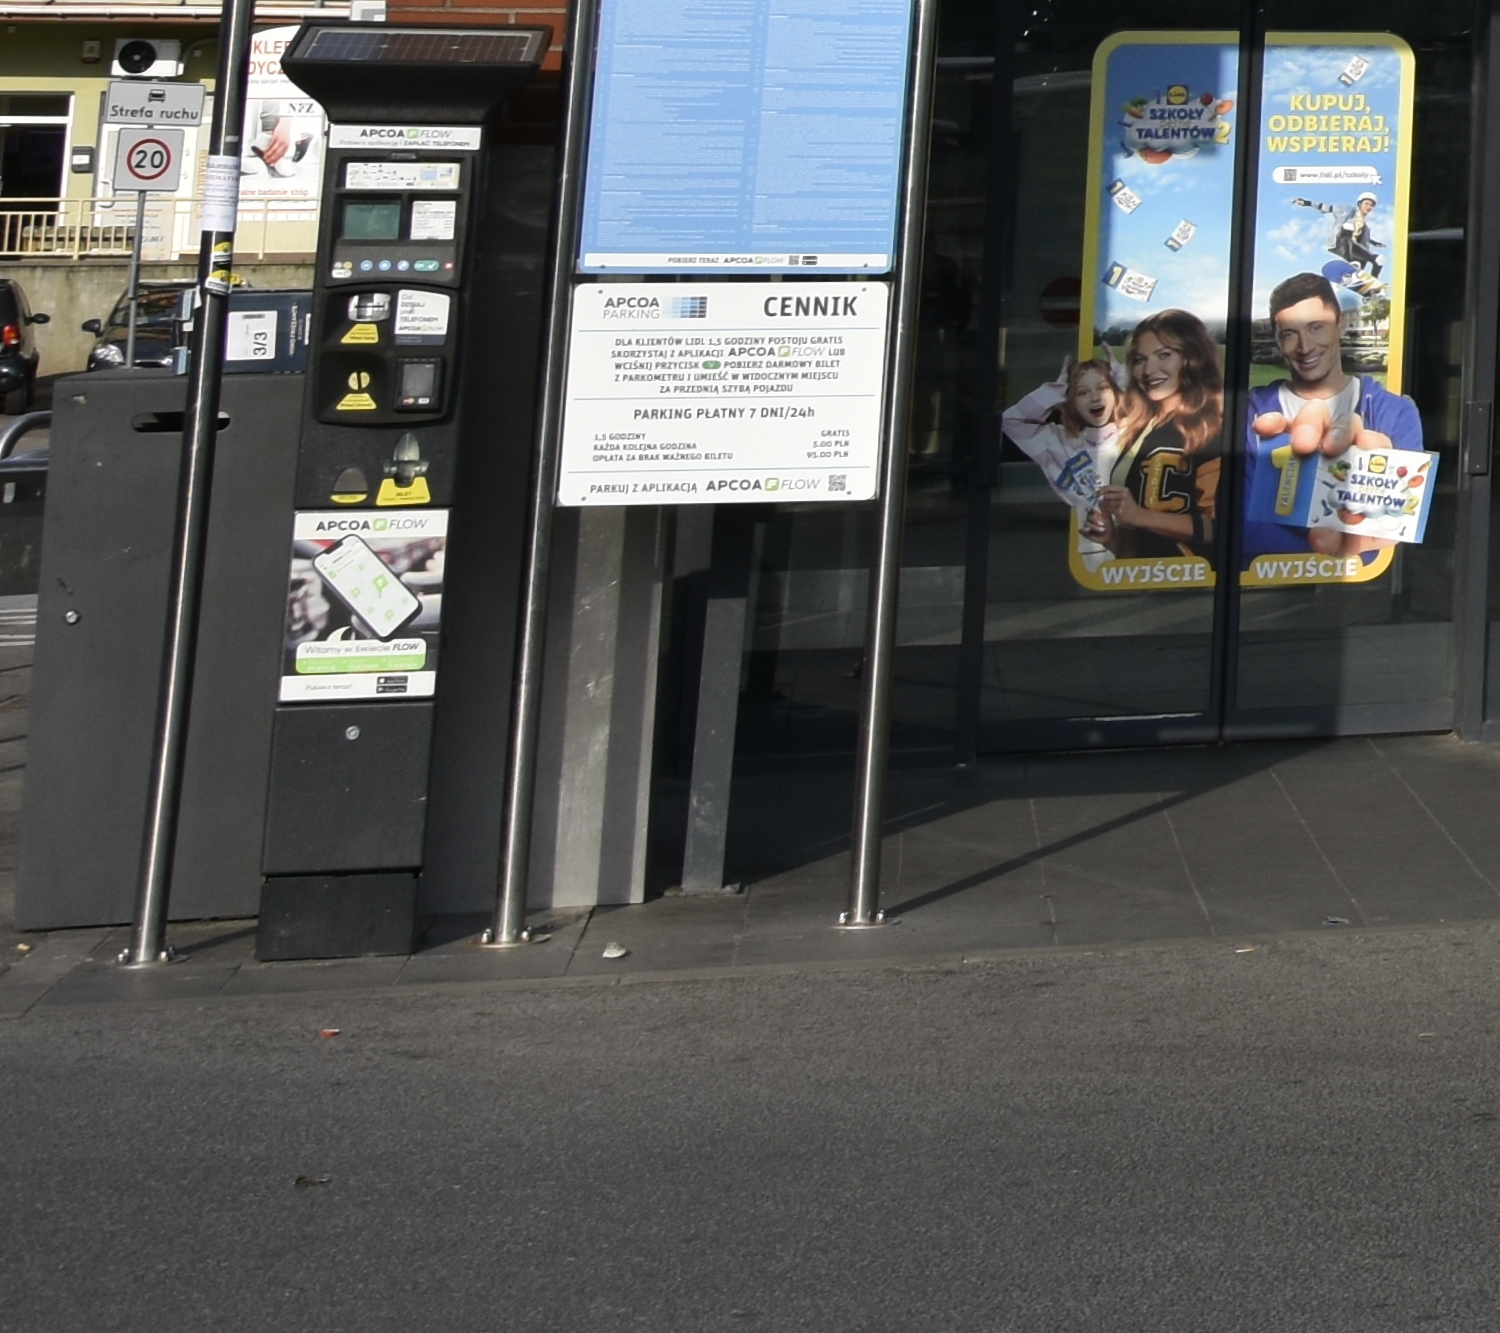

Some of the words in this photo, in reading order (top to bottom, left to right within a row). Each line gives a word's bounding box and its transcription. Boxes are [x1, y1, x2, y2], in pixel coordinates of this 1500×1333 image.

[110, 104, 153, 119] Strefa
[160, 109, 199, 120] ruchu
[1291, 95, 1371, 114] KUPUJ,
[1149, 107, 1204, 122] SZKOŁY
[360, 129, 404, 138] APCOA
[1136, 125, 1216, 140] TALENTÓW
[1215, 122, 1231, 144] 2
[1269, 115, 1390, 136] ODBIERAJ,
[1267, 136, 1390, 153] WSPIERAJ!
[134, 149, 164, 168] 20
[604, 297, 660, 308] APCOA
[764, 296, 858, 317] CENNIK
[603, 309, 660, 319] PARKING
[253, 332, 267, 355] 3/3
[615, 338, 632, 346] DLA
[636, 336, 683, 346] KLIENTÓW
[685, 337, 705, 346] LIDL
[724, 337, 766, 345] GODZINY
[810, 336, 842, 345] GRATIS
[728, 347, 775, 357] APCOA
[792, 347, 825, 356] FLOW
[634, 408, 692, 420] PARKING
[696, 407, 745, 419] PŁATNY
[750, 408, 756, 418] 7
[760, 406, 815, 420] DNI/24h
[590, 484, 629, 494] PARKUJ
[632, 483, 639, 493] Z
[641, 483, 698, 494] APLIKACJĄ
[705, 479, 762, 491] APCOA
[781, 479, 820, 490] FLOW
[1350, 473, 1398, 490] SZKOŁY
[1338, 490, 1405, 508] TALENTÓW
[1402, 495, 1417, 515] 2
[316, 520, 370, 531] APCOA
[389, 518, 428, 529] FLOW
[1102, 560, 1206, 585] WYJŚCIE
[1255, 557, 1357, 580] WYJŚCIE
